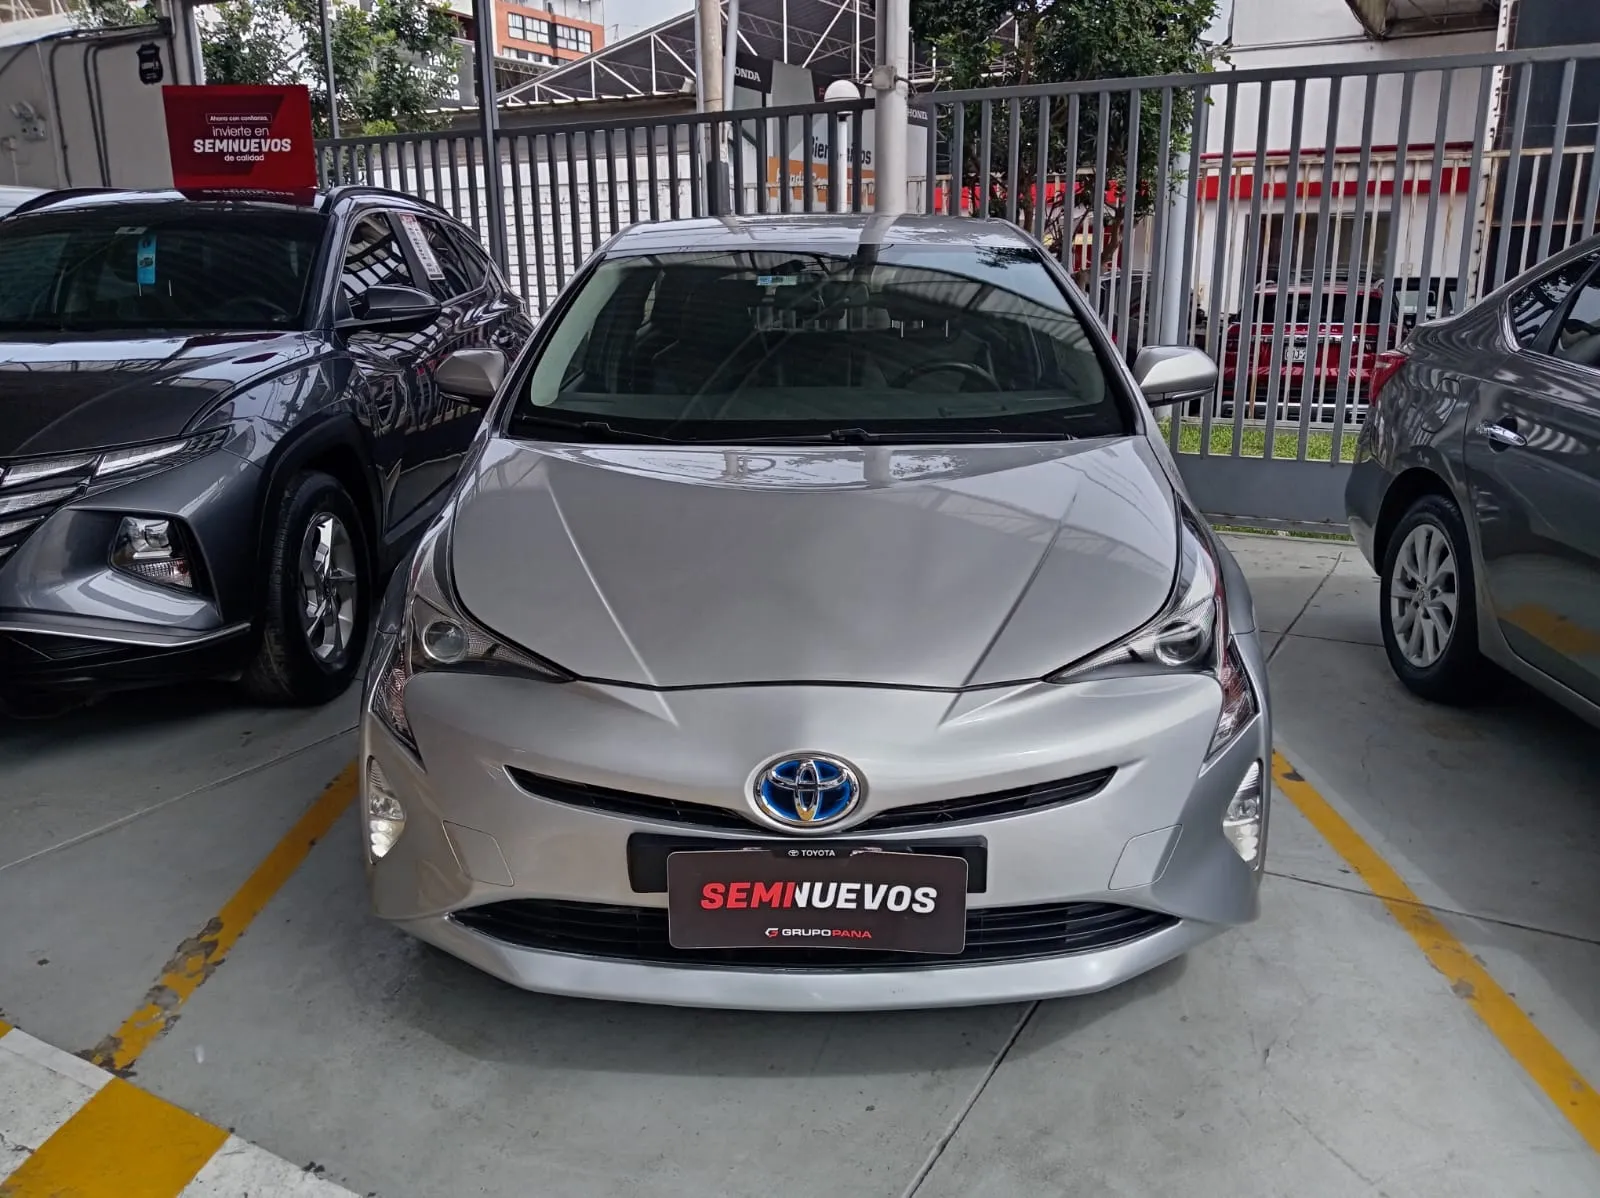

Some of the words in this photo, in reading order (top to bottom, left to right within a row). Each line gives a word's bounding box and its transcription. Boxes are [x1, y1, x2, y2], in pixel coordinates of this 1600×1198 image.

[735, 67, 761, 82] ONDA
[212, 125, 252, 137] invierte
[254, 127, 270, 137] en
[224, 154, 235, 162] de
[236, 153, 265, 161] calidad
[801, 849, 836, 857] TOYOTA
[700, 881, 938, 914] SEMINUEVOS
